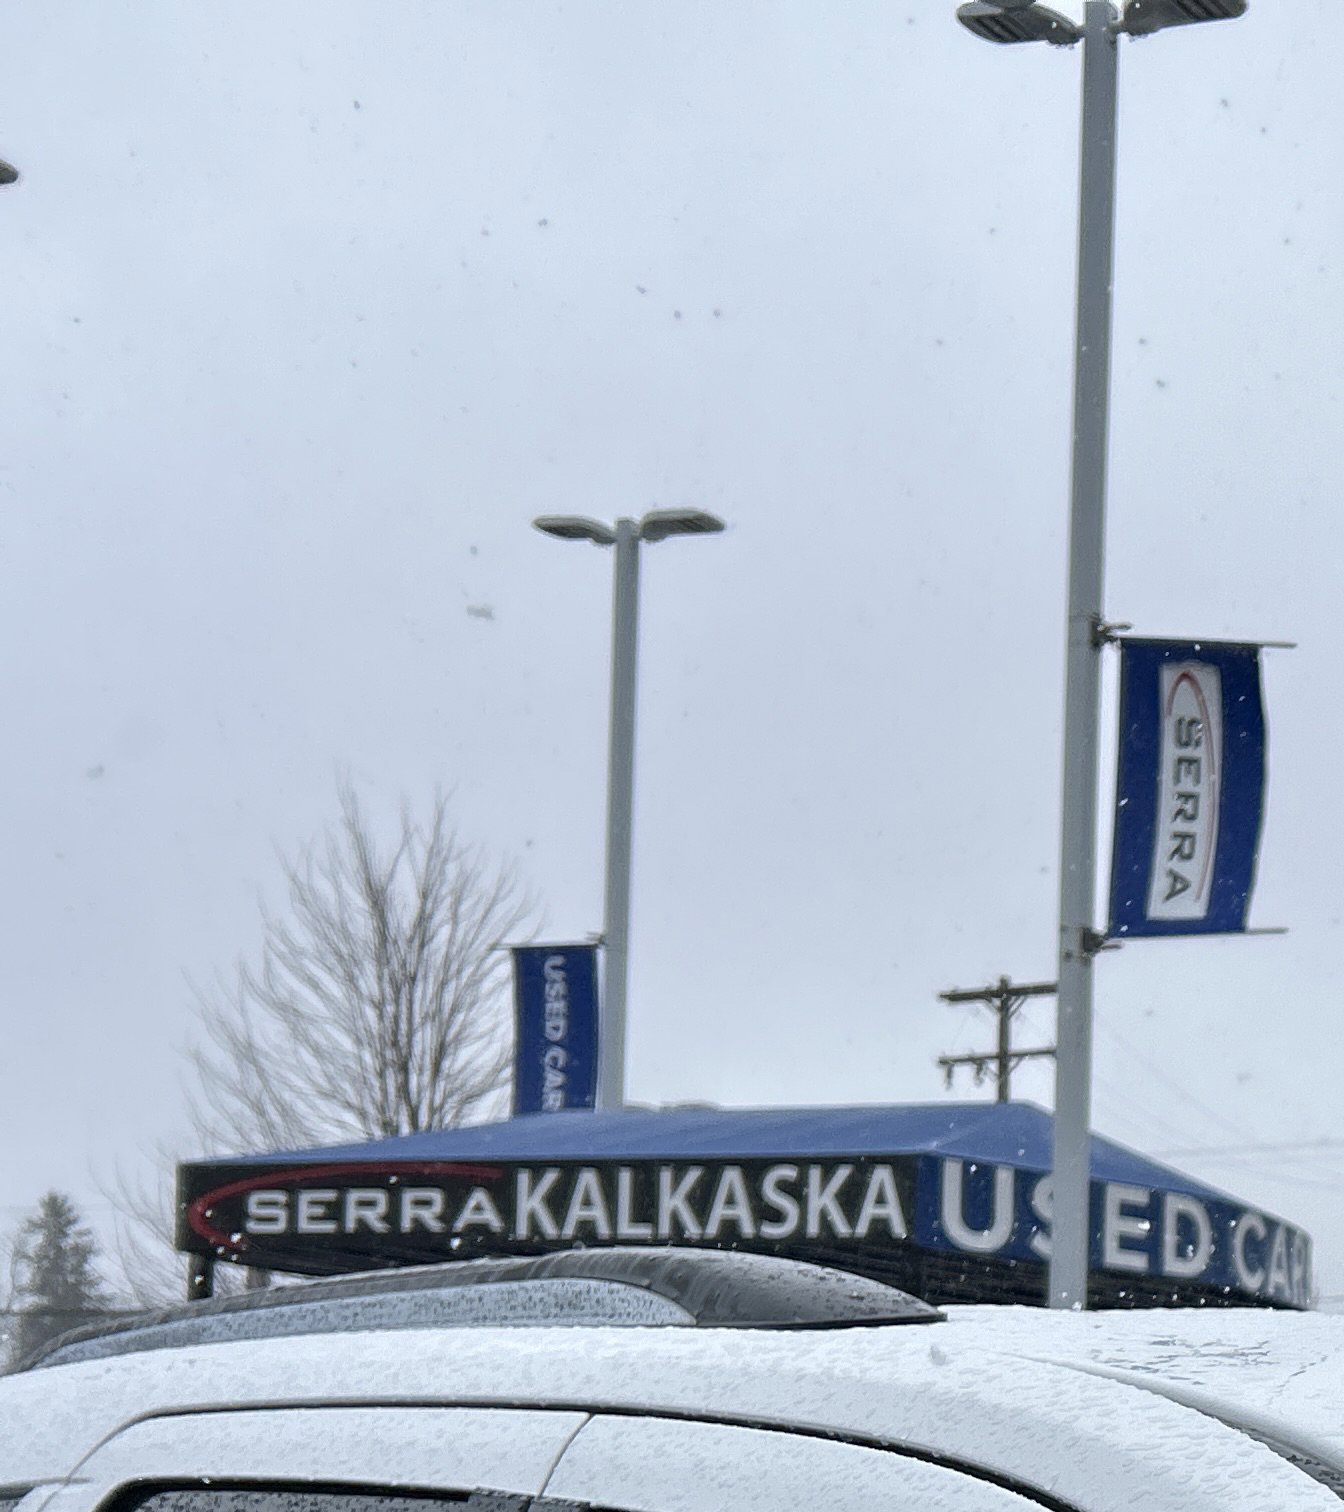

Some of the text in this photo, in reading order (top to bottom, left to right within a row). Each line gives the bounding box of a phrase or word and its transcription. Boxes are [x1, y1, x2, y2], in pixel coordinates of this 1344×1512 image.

[1163, 715, 1202, 901] SERRA
[543, 954, 569, 1042] USED
[245, 1163, 908, 1240] SERRA KALKASKA
